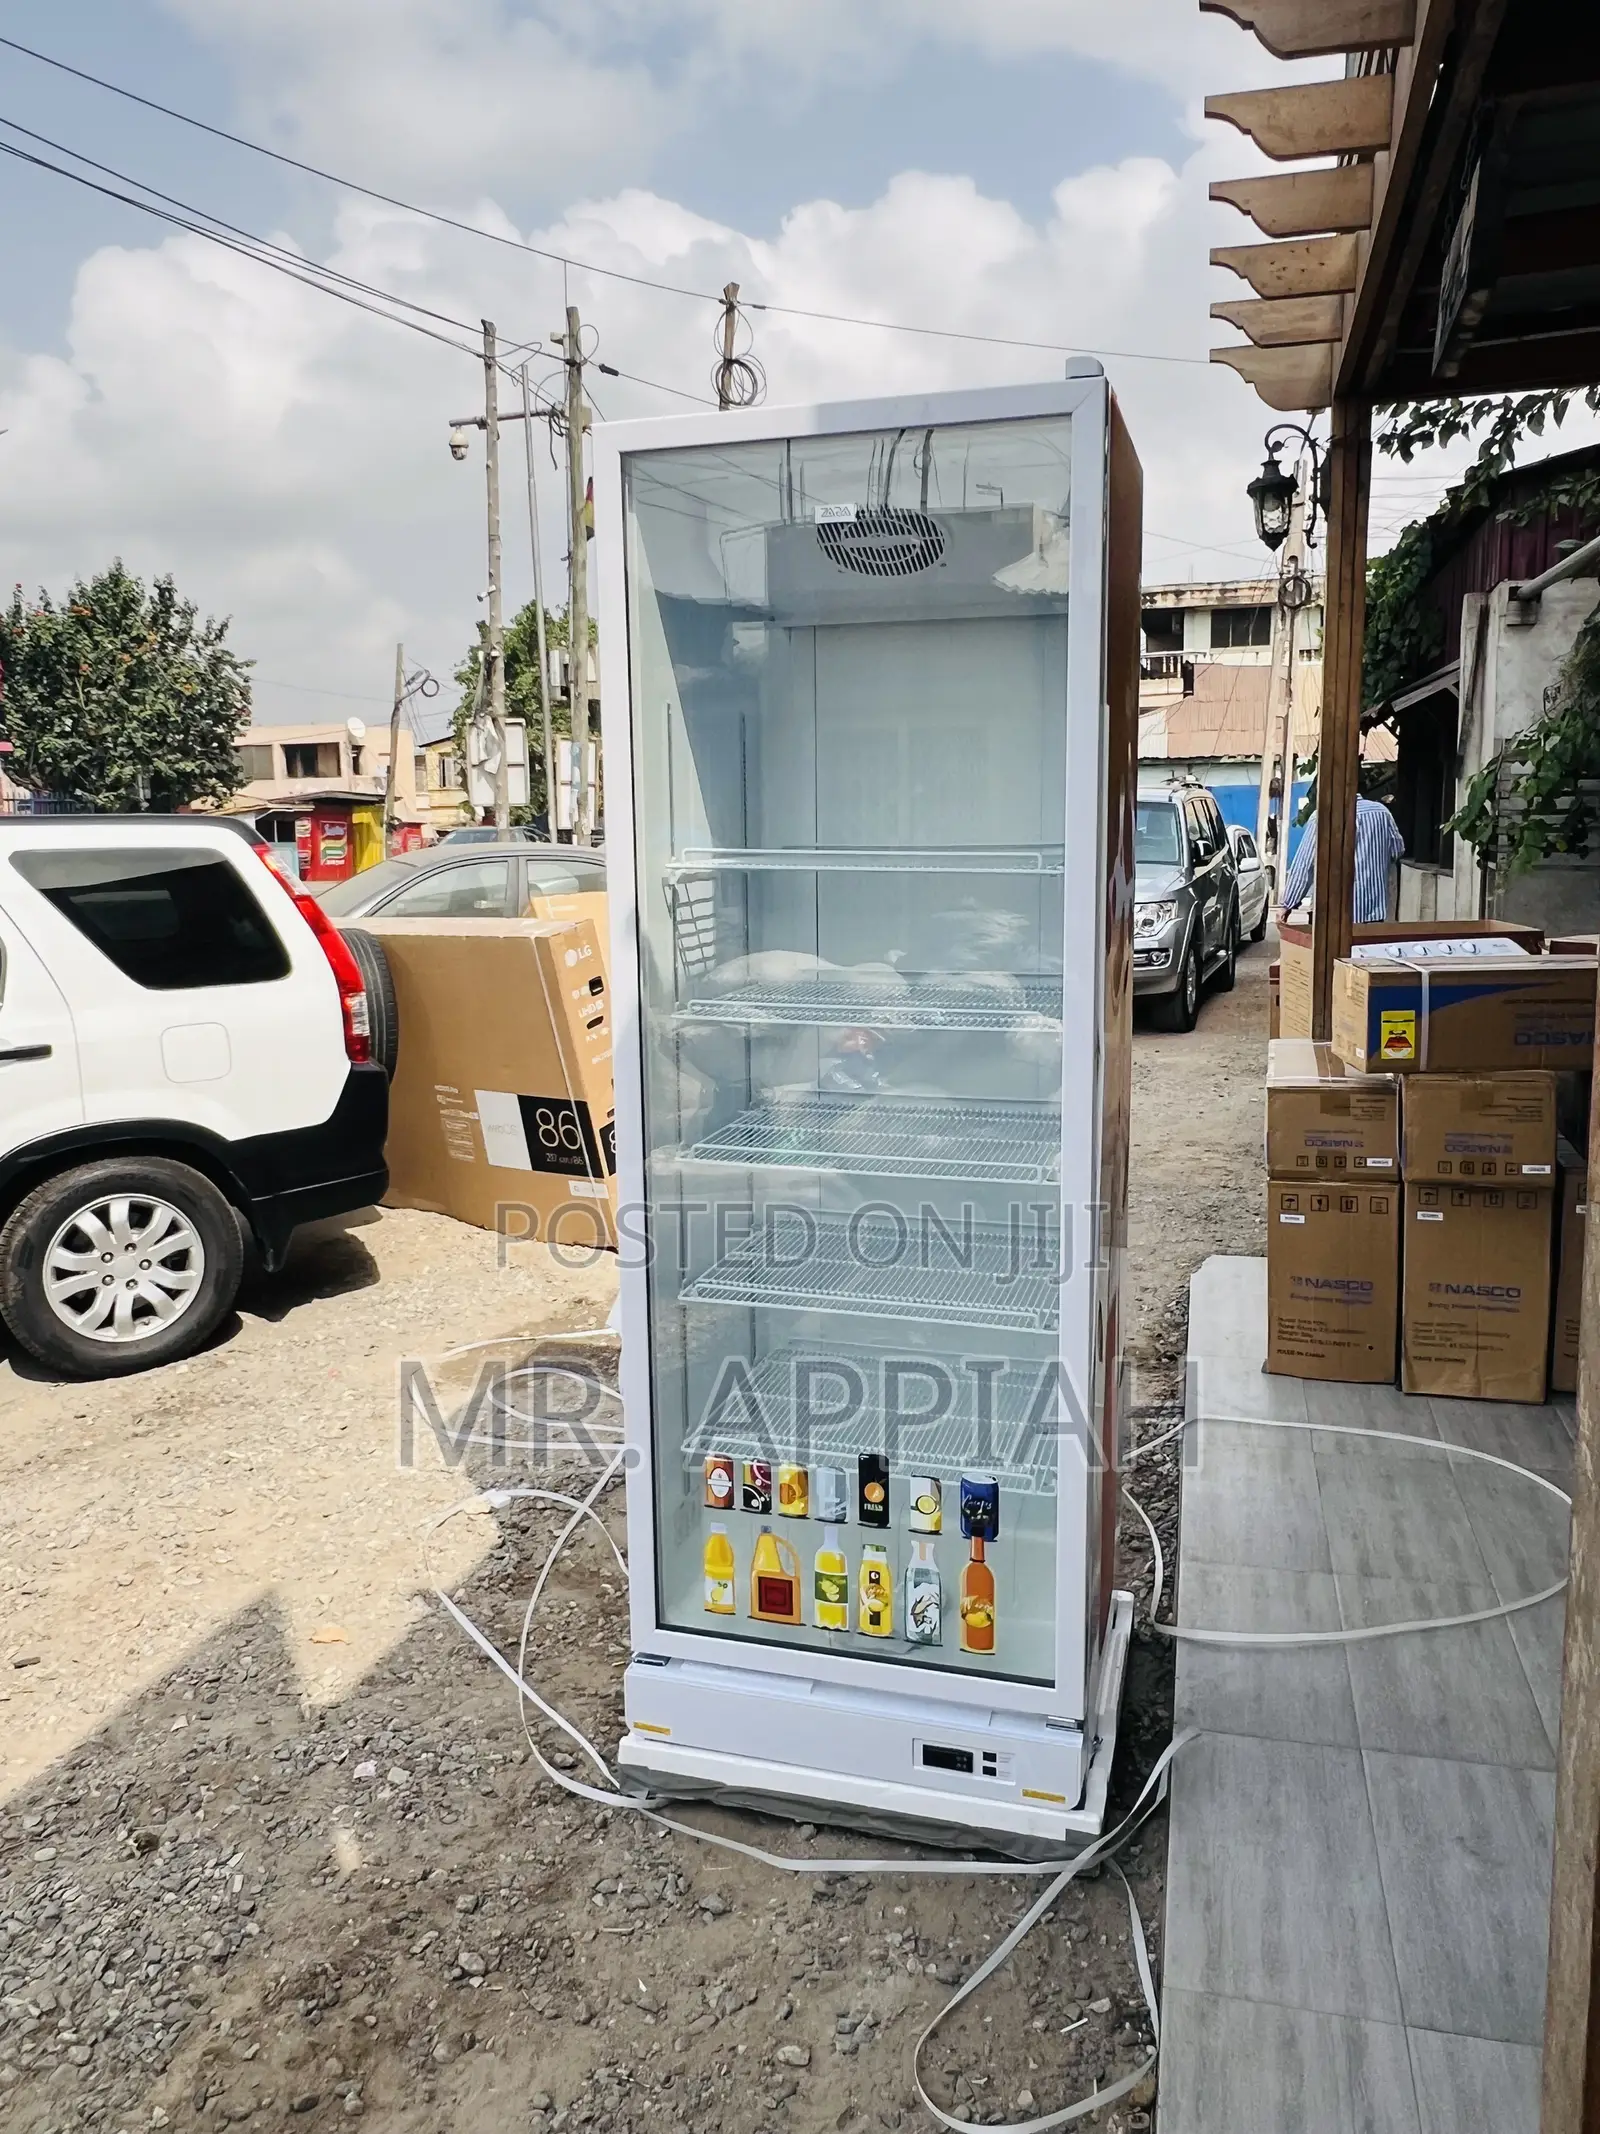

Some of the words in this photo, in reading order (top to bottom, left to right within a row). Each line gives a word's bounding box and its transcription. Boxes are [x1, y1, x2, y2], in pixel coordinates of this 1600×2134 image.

[577, 945, 592, 959] LG
[536, 1108, 581, 1150] 86
[1305, 1277, 1374, 1291] NASCO
[1446, 1284, 1521, 1298] NASCO
